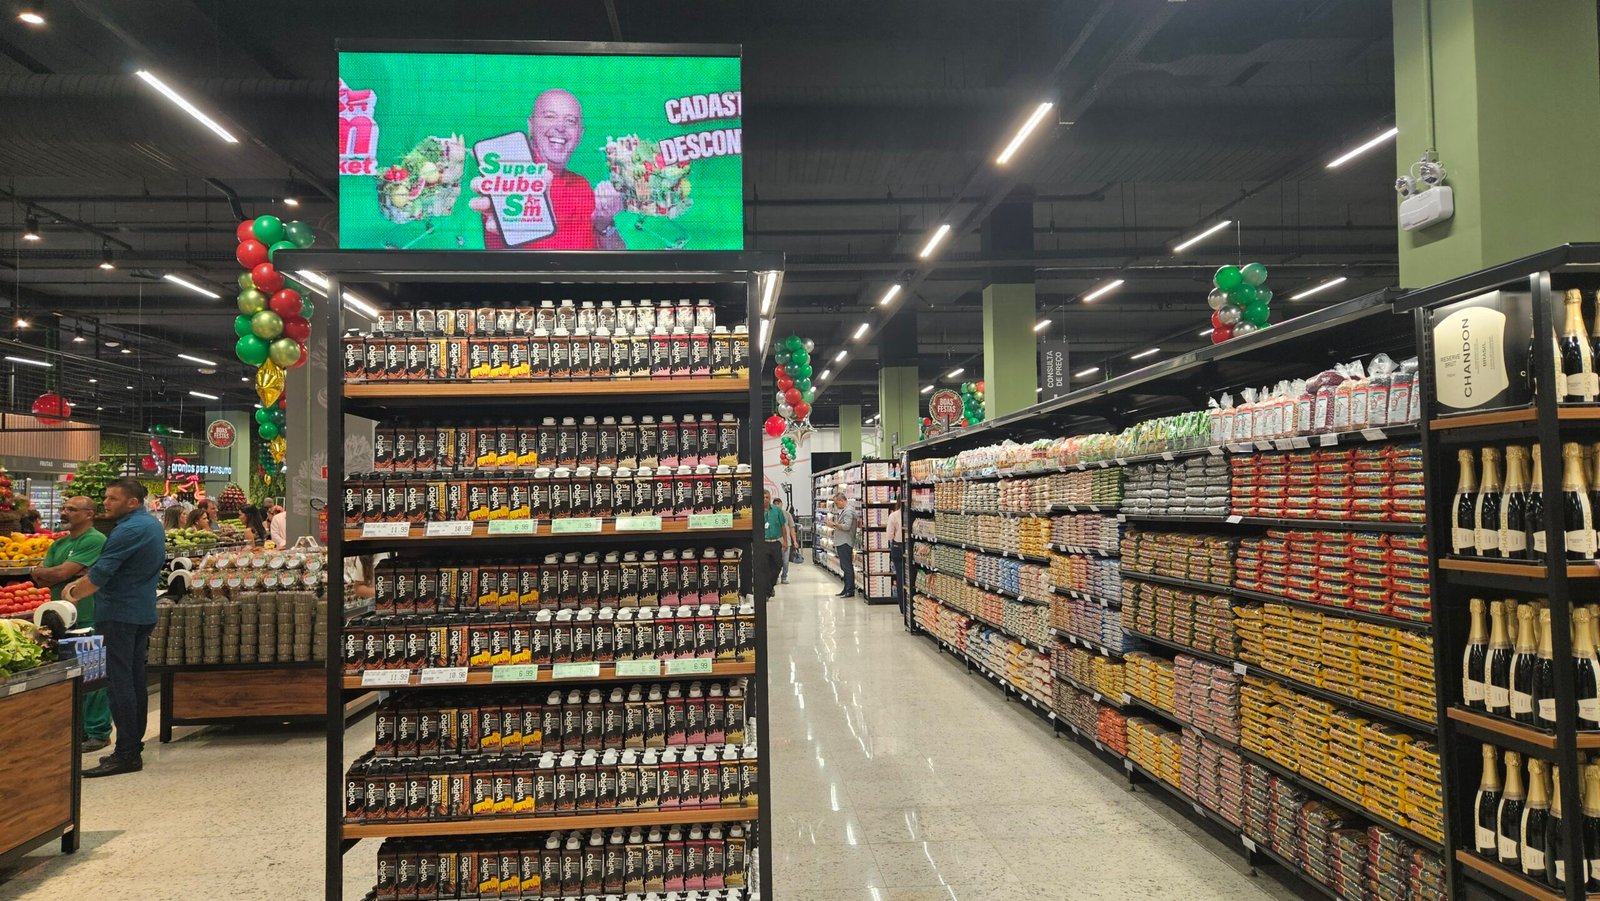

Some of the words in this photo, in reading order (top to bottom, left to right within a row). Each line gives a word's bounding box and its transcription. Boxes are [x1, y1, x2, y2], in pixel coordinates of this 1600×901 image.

[482, 152, 545, 176] Super
[481, 176, 544, 192] clube
[1462, 318, 1472, 398] CHANDON
[1056, 376, 1062, 386] DE
[938, 404, 956, 413] FESTAS
[171, 463, 196, 474] prontos
[196, 464, 208, 475] para
[210, 465, 232, 475] consumo
